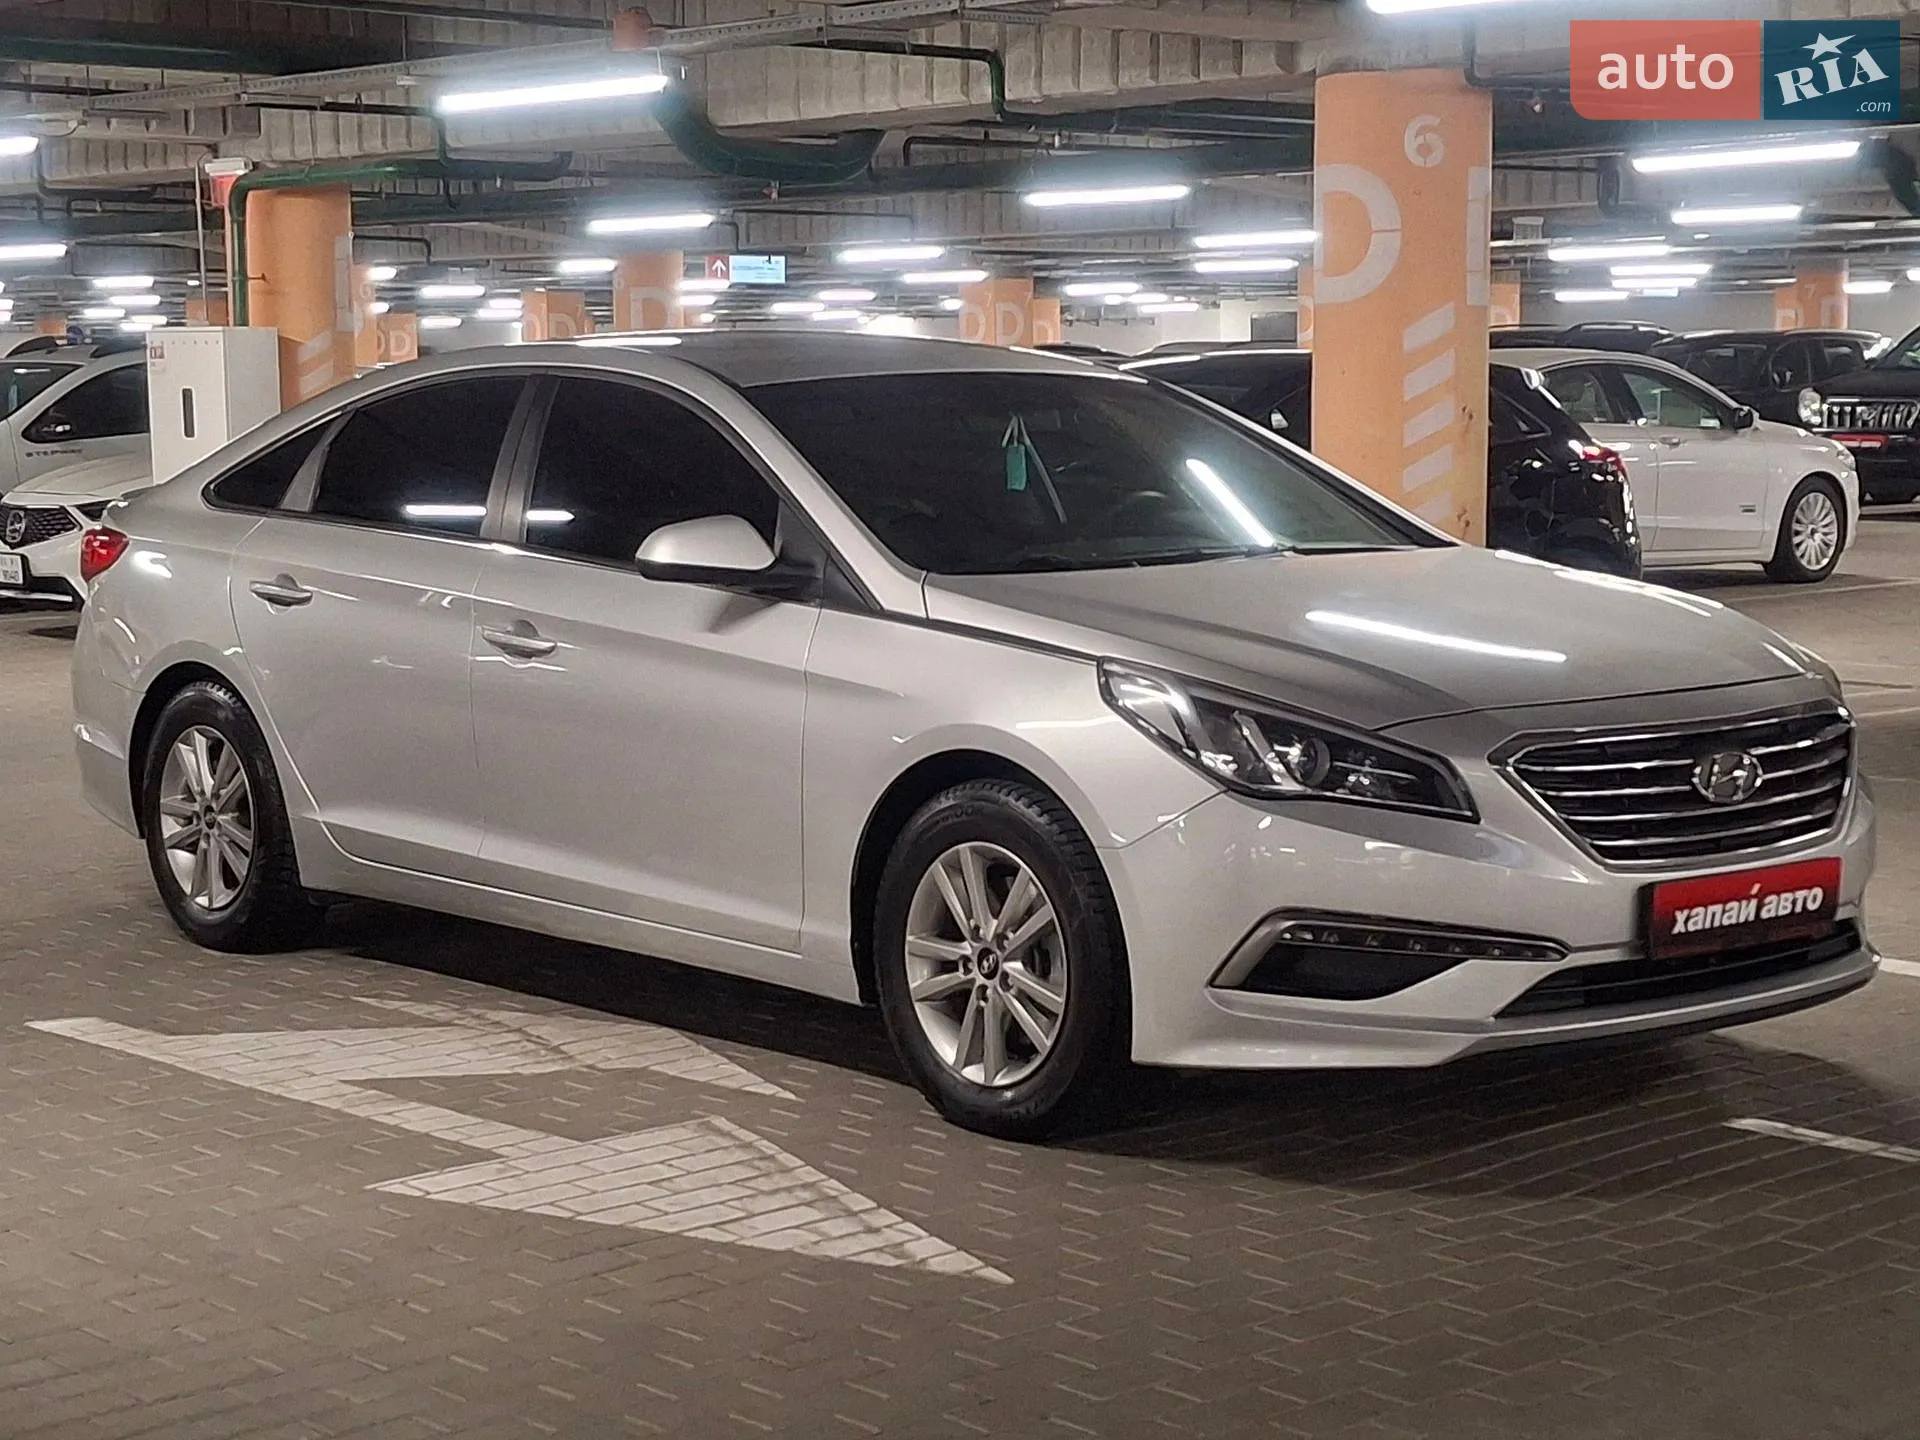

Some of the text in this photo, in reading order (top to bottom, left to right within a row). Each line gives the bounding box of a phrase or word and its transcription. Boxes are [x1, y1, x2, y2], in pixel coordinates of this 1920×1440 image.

[1404, 114, 1444, 168] 6
[1313, 163, 1402, 305] D
[390, 330, 413, 356] D
[996, 302, 1025, 345] D
[1760, 887, 1824, 919] авто
